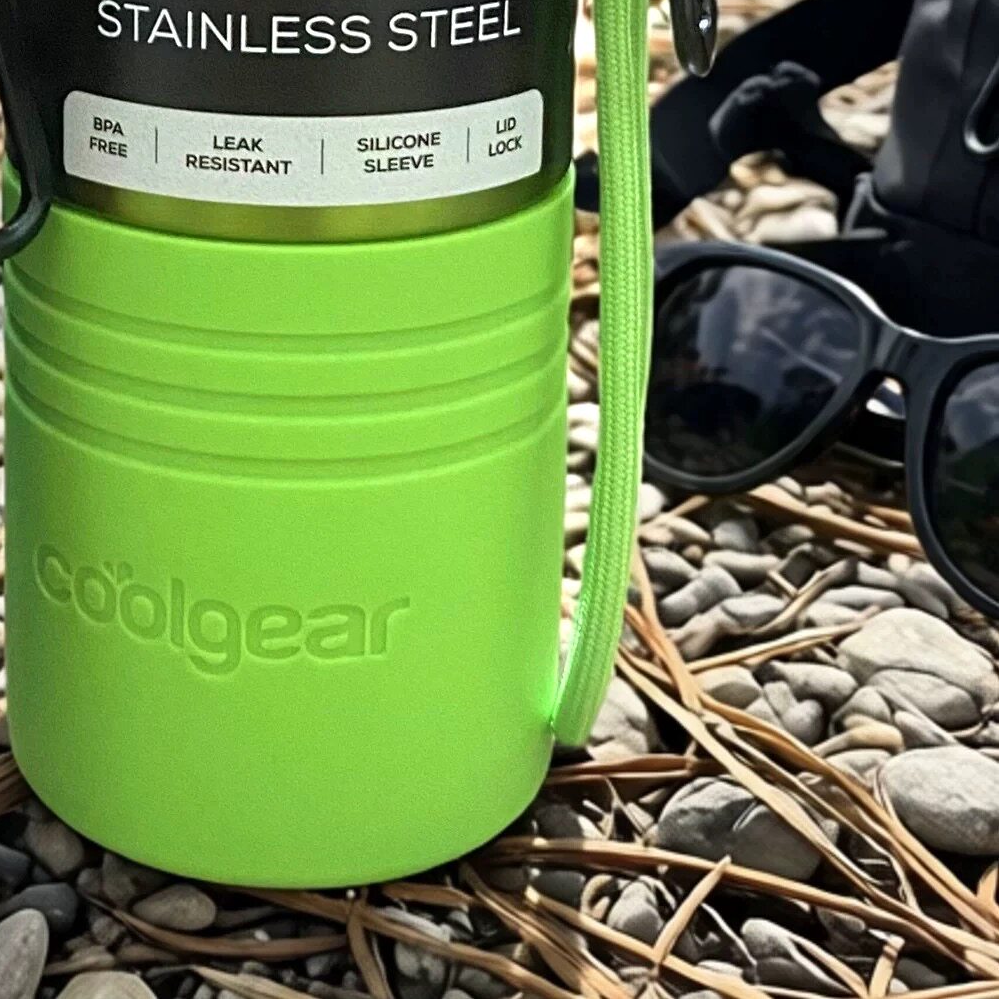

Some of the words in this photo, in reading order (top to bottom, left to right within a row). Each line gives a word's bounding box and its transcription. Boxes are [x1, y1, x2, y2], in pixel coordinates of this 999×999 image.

[388, 0, 521, 50] STEEL
[92, 116, 124, 137] BPA
[495, 116, 516, 134] LID
[89, 137, 128, 159] FREE
[213, 135, 263, 153] LEAK
[356, 131, 441, 153] SILICONE
[488, 135, 522, 158] LOCK
[185, 155, 292, 175] RESISTANT
[363, 153, 434, 175] SLEEVE
[35, 543, 411, 678] coolgear
